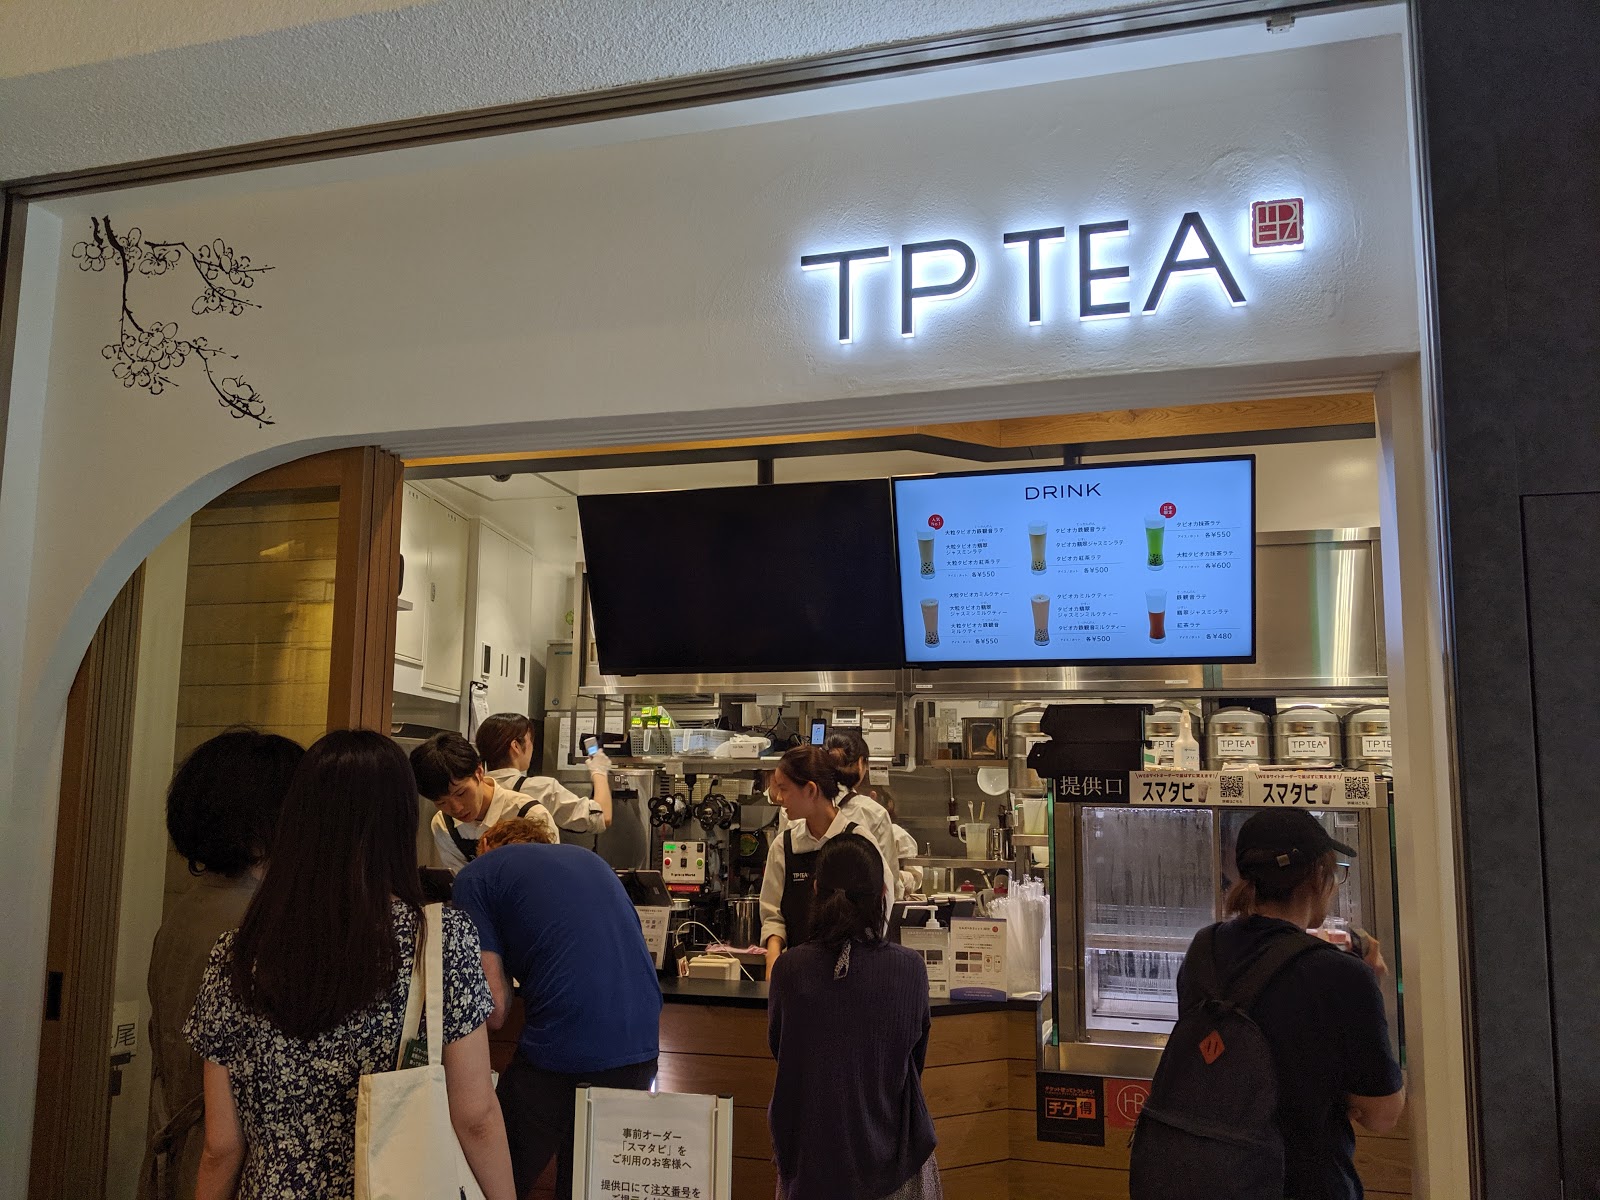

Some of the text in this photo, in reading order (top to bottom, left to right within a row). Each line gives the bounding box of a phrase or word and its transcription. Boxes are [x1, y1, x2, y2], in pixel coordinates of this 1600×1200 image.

[800, 211, 1247, 342] TP TEA
[1025, 482, 1102, 500] DRINK
[1221, 740, 1252, 748] TP TEA
[1292, 741, 1324, 749] TP TEA
[1060, 776, 1123, 796] 提供口
[1142, 782, 1195, 802] スマタピ
[1263, 783, 1318, 804] スマタピ
[622, 1128, 682, 1141] 事前オーダー
[622, 1140, 687, 1157] 「スマタピ」を
[612, 1153, 692, 1170] ご利用のお客様へ
[600, 1179, 701, 1199] 提供口にて注文番号を
